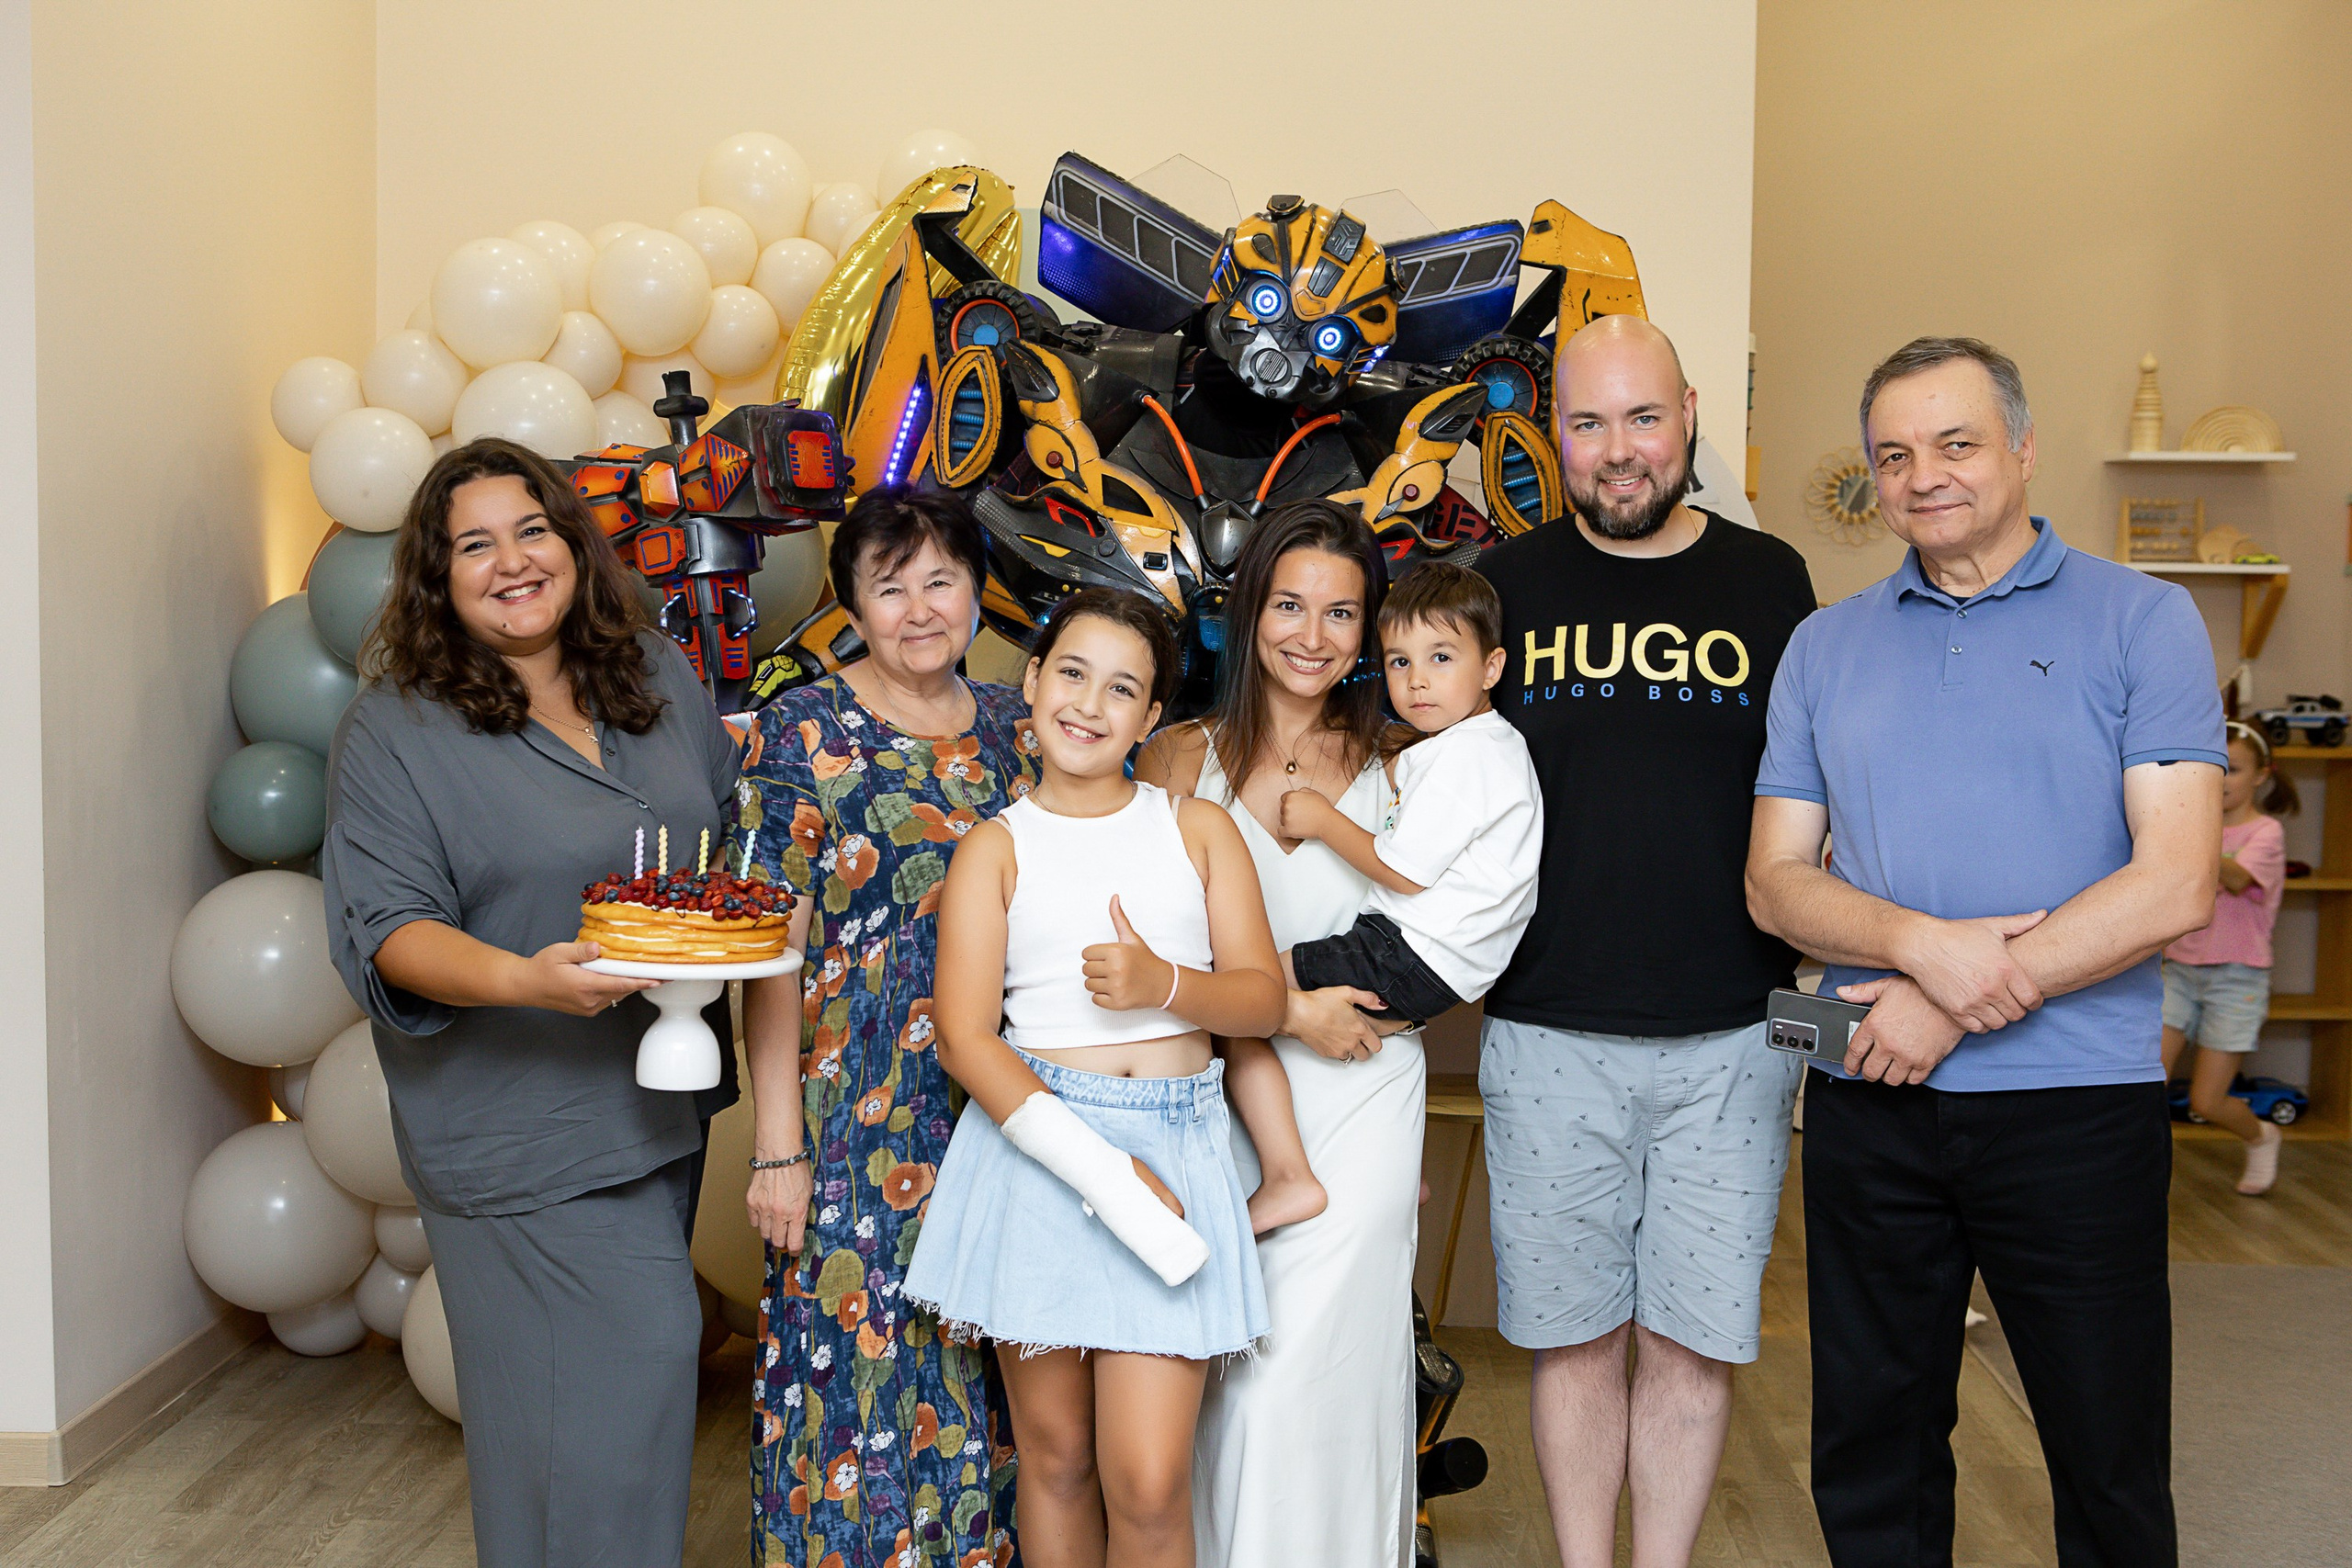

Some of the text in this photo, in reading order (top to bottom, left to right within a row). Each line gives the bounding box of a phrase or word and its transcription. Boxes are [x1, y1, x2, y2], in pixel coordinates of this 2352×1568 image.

[1523, 622, 1750, 687] HUGO
[1523, 682, 1750, 706] HUGO BOSS
